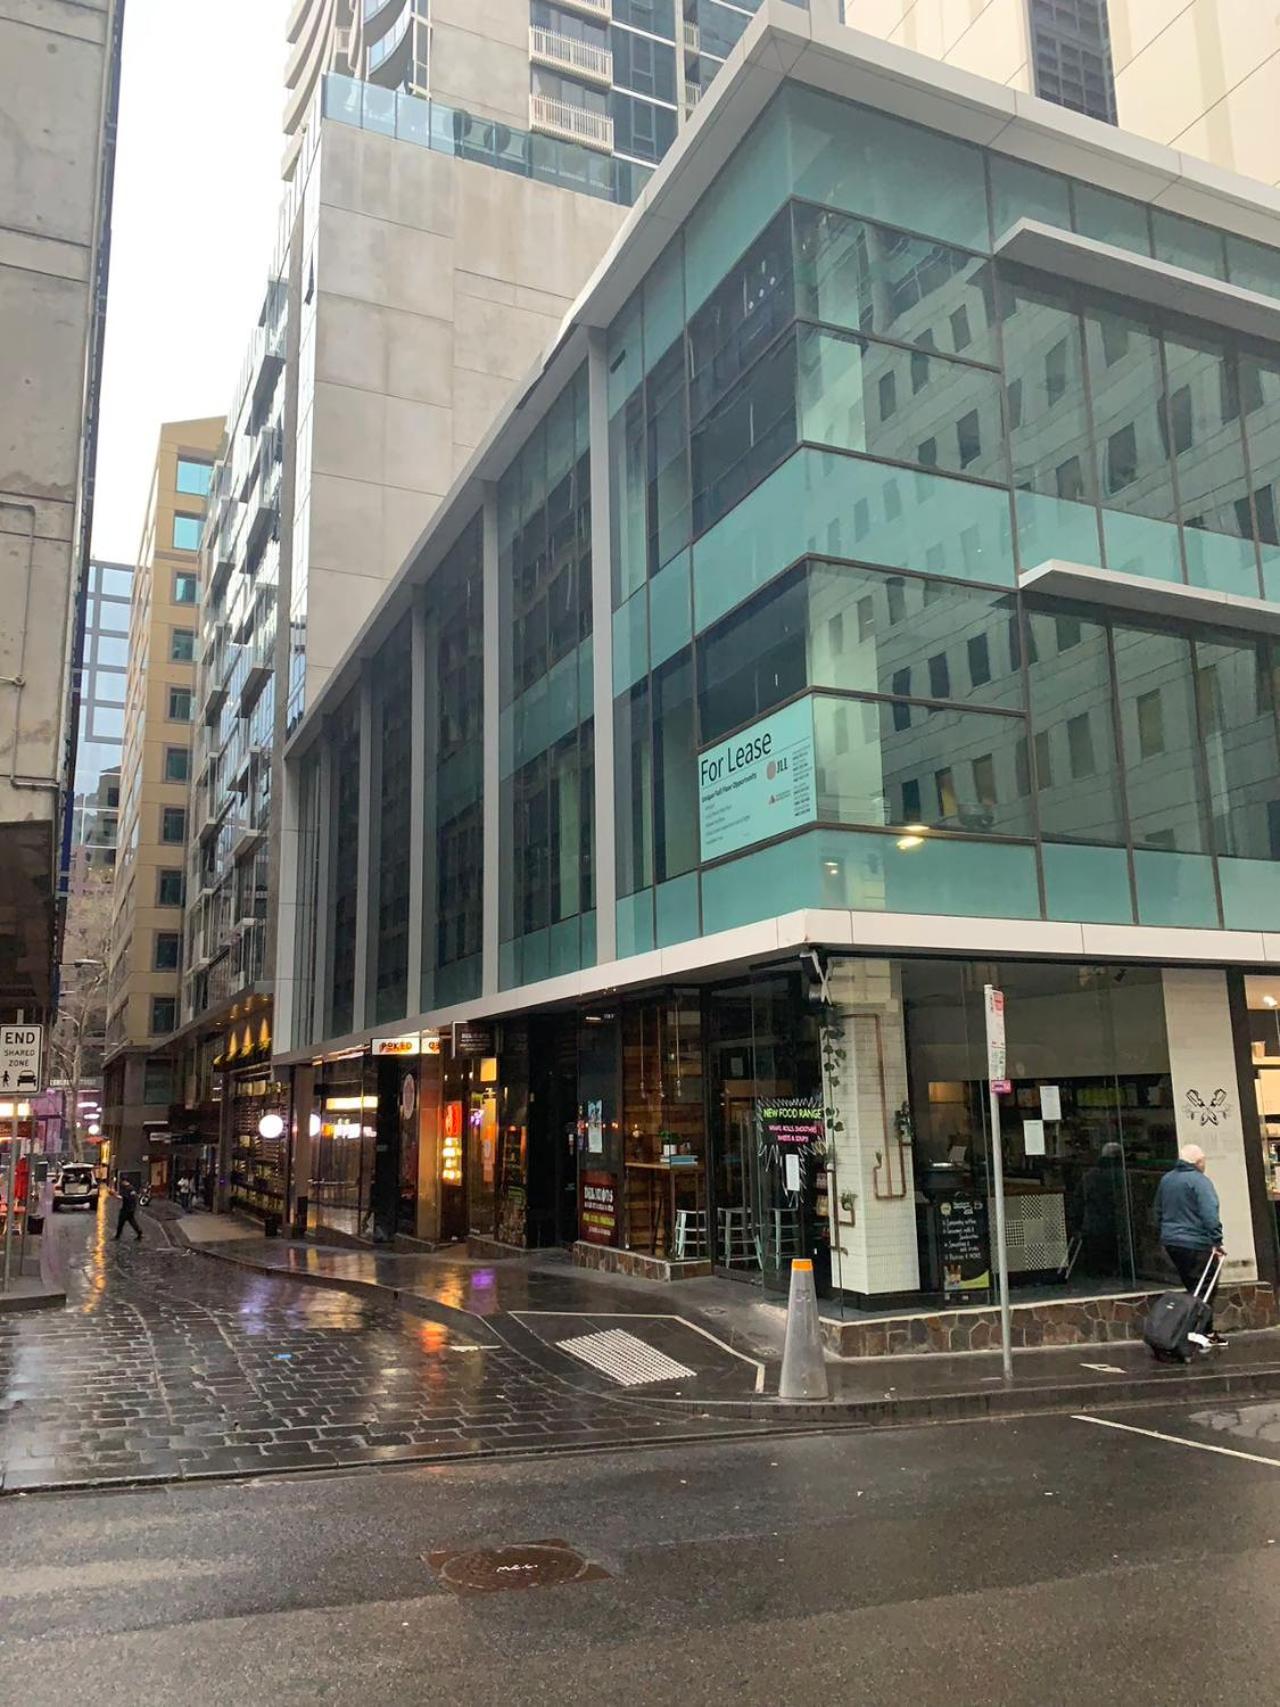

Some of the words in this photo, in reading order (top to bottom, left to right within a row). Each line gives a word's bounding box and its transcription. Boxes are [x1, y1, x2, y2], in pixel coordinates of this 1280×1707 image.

[701, 757, 724, 786] For
[728, 733, 772, 773] Lease
[5, 1032, 35, 1045] END
[4, 1048, 35, 1057] SHARED
[8, 1059, 30, 1067] ZONE
[763, 1108, 778, 1118] NEW
[779, 1108, 798, 1119] FOOD
[799, 1108, 822, 1119] RANGE
